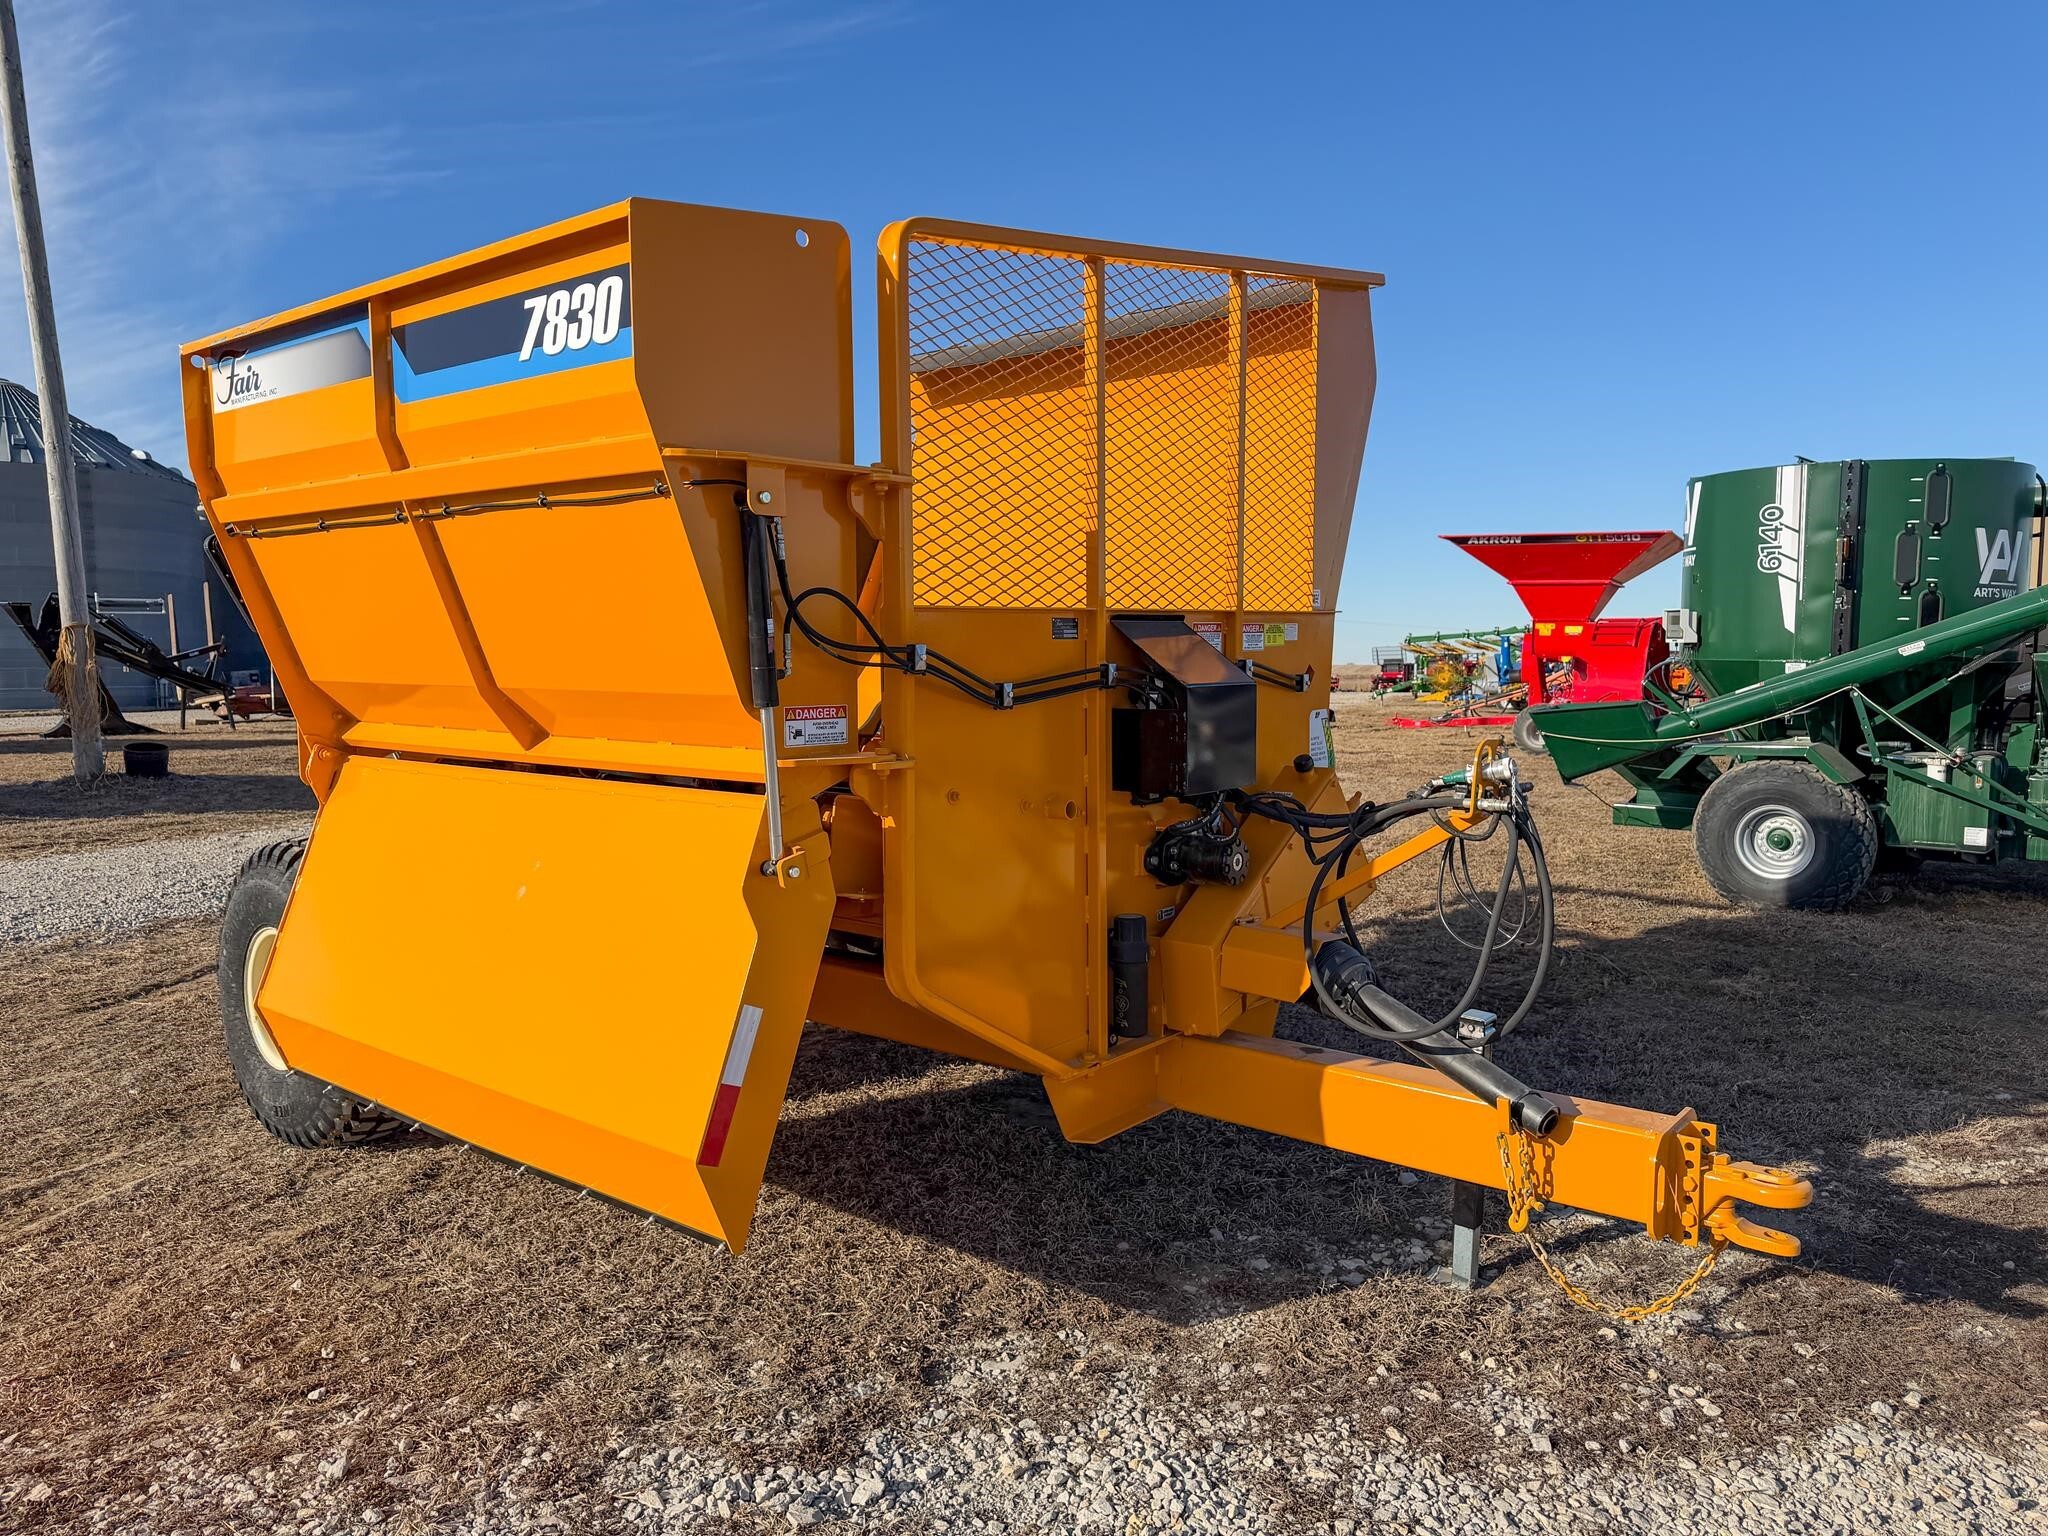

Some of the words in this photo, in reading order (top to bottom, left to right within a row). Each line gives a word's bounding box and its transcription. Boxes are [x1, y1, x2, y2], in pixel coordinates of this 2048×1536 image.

[518, 275, 623, 361] 7830
[216, 348, 262, 405] Fair
[1467, 536, 1522, 545] AKRON
[1757, 503, 1784, 574] 6140
[1973, 587, 2000, 598] ART'S
[2001, 588, 2017, 599] WAY
[1198, 624, 1217, 632] DANGER
[795, 707, 837, 720] DANGER
